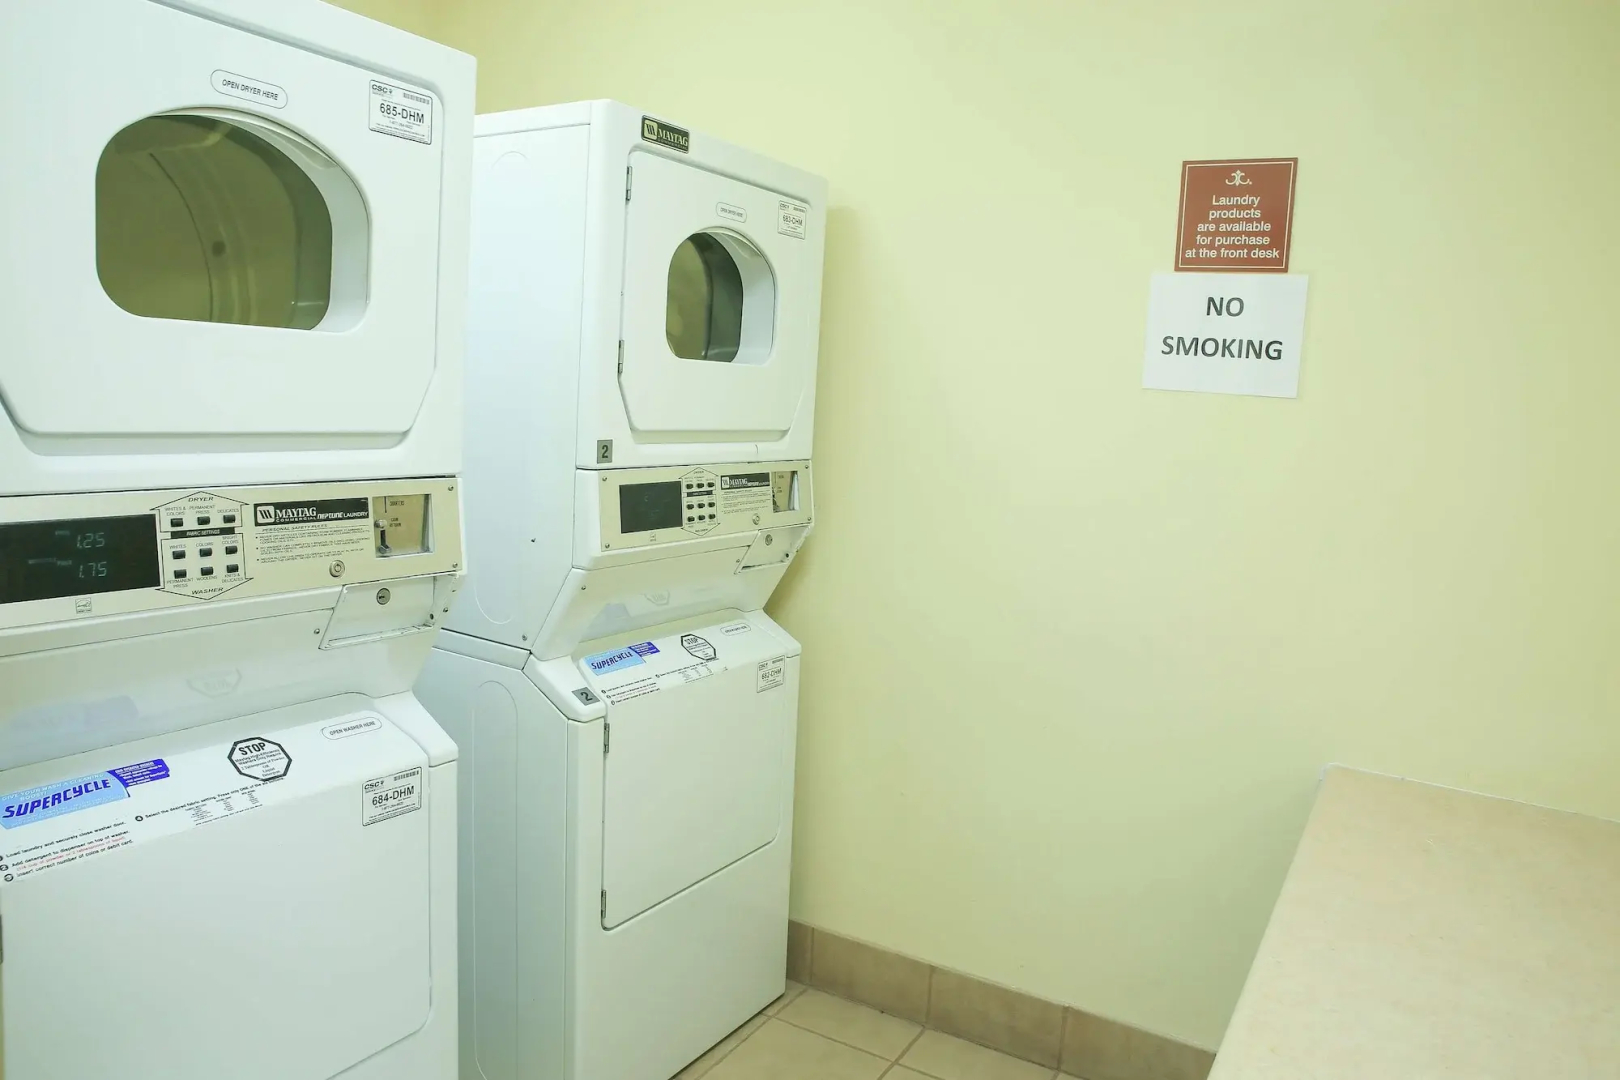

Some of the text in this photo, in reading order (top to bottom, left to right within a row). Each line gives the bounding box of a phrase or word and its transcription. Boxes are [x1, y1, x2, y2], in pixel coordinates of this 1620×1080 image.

[221, 79, 279, 101] OPEN DRYER HERE
[372, 84, 388, 93] CSC
[380, 102, 424, 124] 685-DHM
[658, 128, 688, 147] MAYTAG
[1212, 195, 1260, 207] Laundry
[1209, 208, 1261, 221] products
[1197, 221, 1271, 232] are available
[1196, 234, 1270, 247] for purchase
[1185, 248, 1280, 259] at the front desk
[1206, 296, 1245, 317] NO
[1161, 335, 1283, 360] SMOKING
[602, 444, 609, 459] 2
[275, 507, 317, 519] MAYTAG
[76, 532, 105, 548] 1.25
[79, 561, 107, 578] 1.75
[192, 587, 224, 595] WASHER
[591, 651, 634, 670] SUPERCYCLE
[580, 691, 593, 702] 2
[343, 724, 363, 733] WASHER
[362, 720, 376, 728] HERE
[238, 742, 266, 756] STOP
[364, 781, 380, 790] CSC
[2, 779, 112, 818] SUPERCYCLE
[372, 785, 415, 806] 684-DHM
[170, 804, 187, 812] desired
[6, 850, 21, 858] Load
[21, 845, 43, 854] laundry
[56, 835, 78, 844] securely
[12, 860, 24, 868] Add
[24, 852, 52, 863] detergent
[60, 842, 86, 852] dispenser
[16, 869, 34, 878] Insert
[35, 862, 56, 872] correct
[57, 856, 77, 865] number
